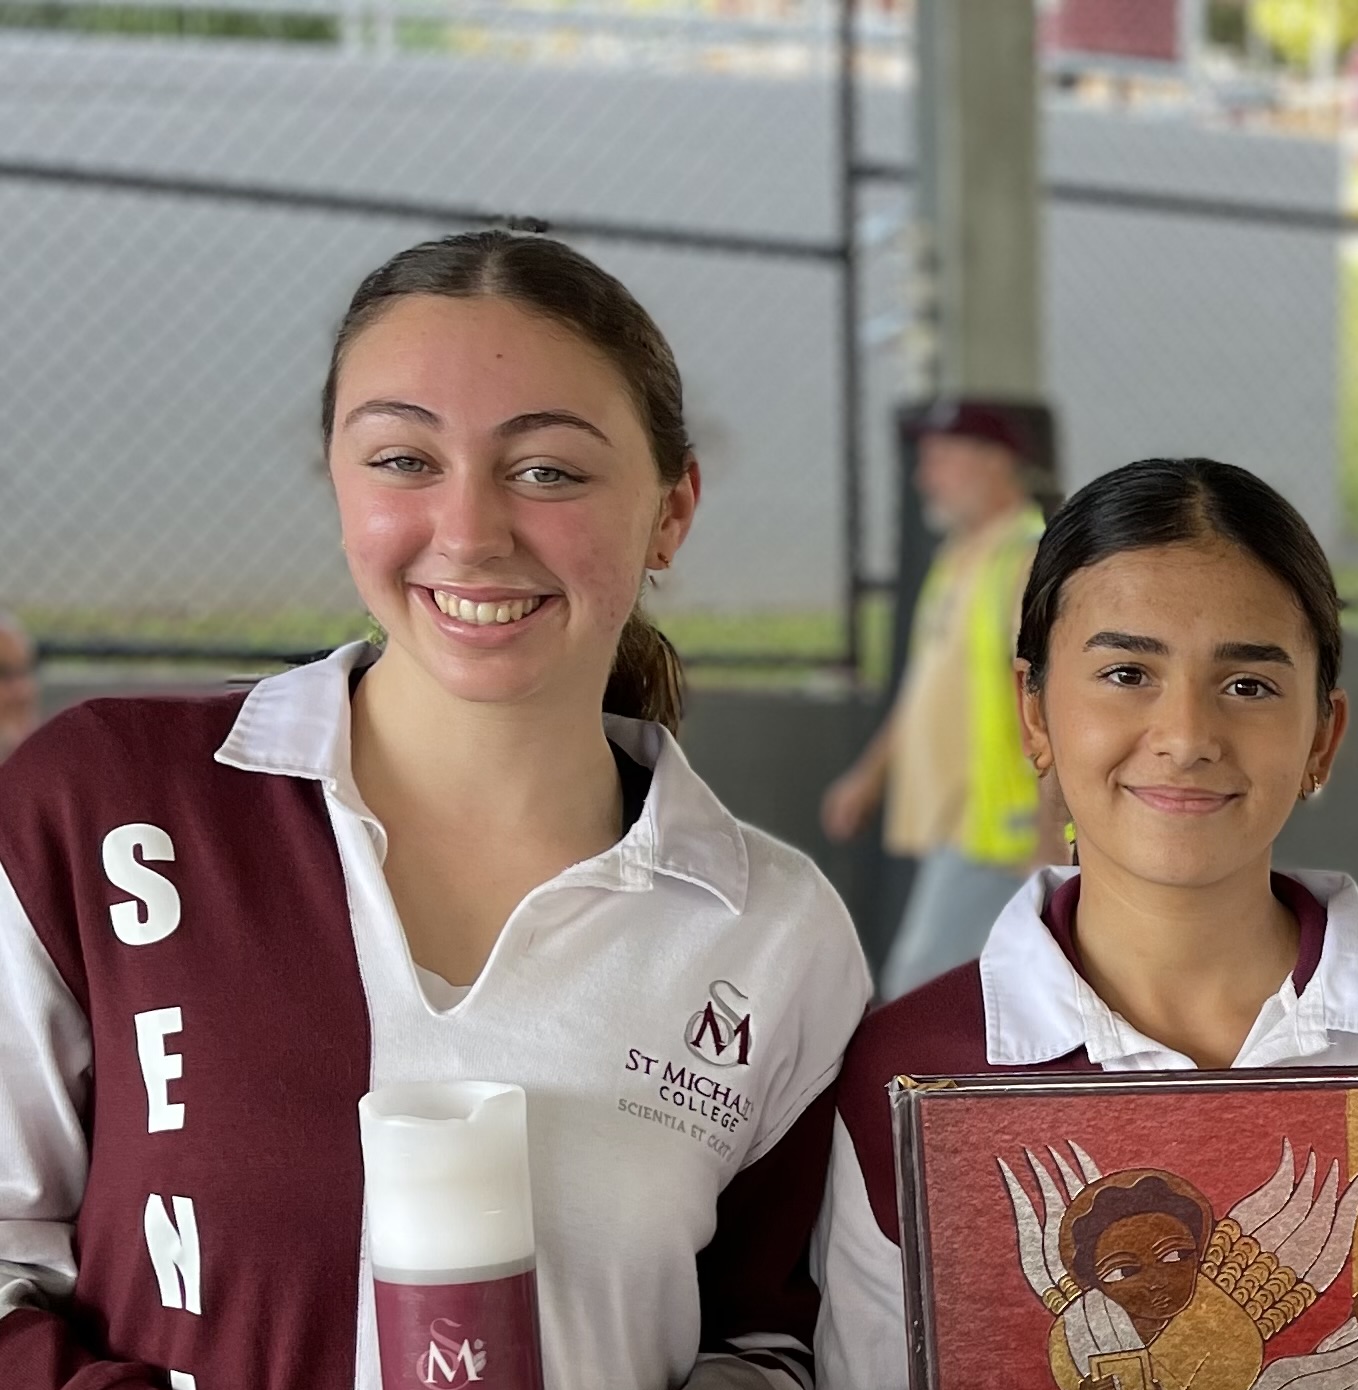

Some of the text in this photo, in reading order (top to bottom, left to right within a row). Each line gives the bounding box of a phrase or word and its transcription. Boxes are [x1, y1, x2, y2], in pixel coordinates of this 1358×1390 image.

[625, 1048, 659, 1075] ST
[618, 1098, 686, 1133] SCIENTIA
[690, 1123, 706, 1142] ET
[659, 1085, 739, 1133] COLLEGE
